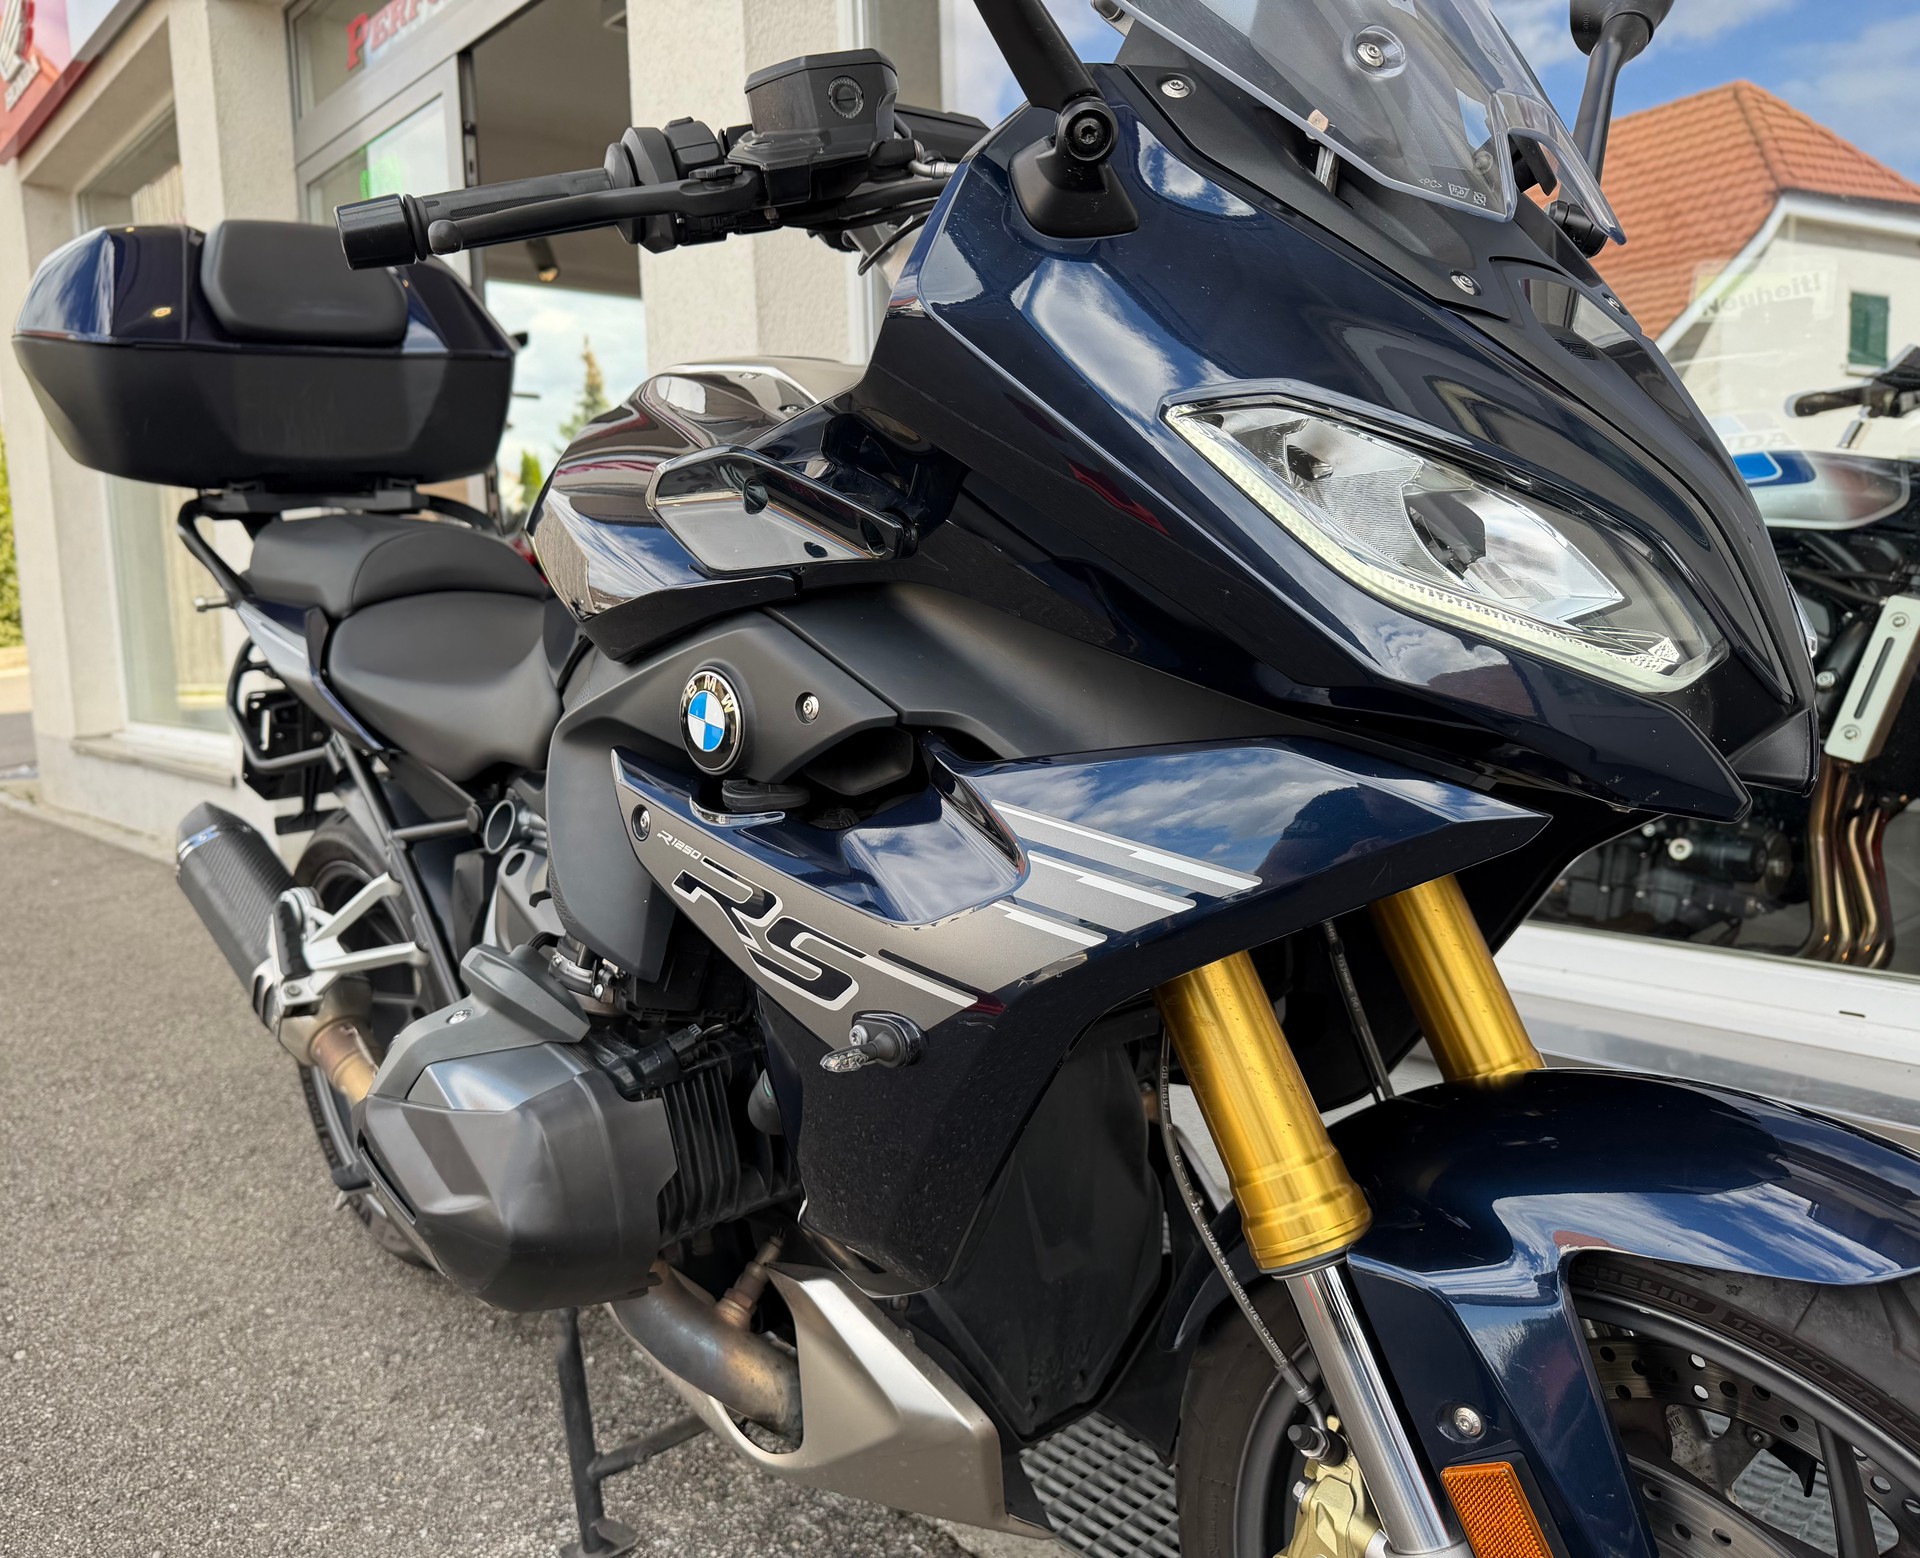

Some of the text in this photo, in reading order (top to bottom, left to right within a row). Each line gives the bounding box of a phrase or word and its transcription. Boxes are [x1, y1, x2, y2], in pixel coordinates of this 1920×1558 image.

[686, 674, 735, 714] BMW
[671, 855, 860, 1012] RS
[1220, 1256, 1235, 1279] SAE
[1579, 1264, 1699, 1309] CHELIN
[1733, 1317, 1832, 1376] 120/70
